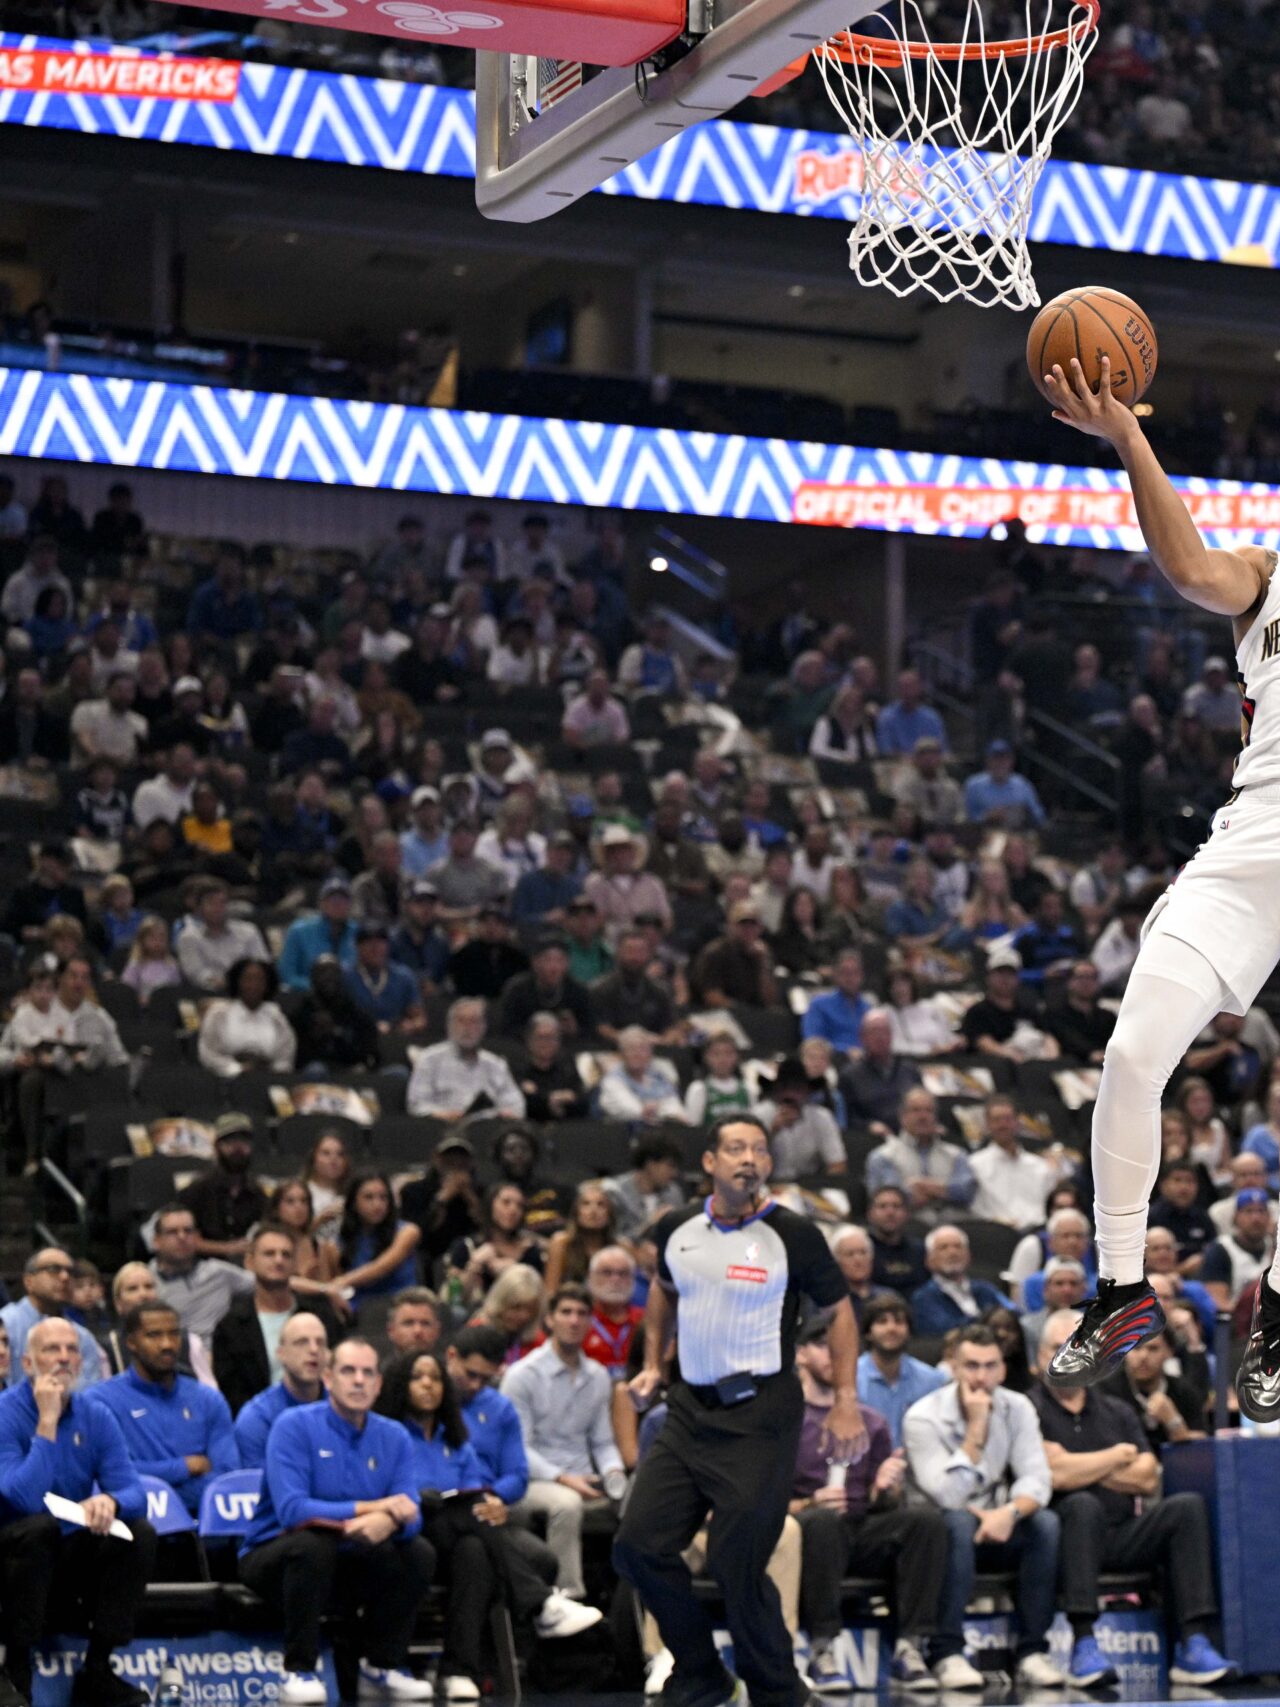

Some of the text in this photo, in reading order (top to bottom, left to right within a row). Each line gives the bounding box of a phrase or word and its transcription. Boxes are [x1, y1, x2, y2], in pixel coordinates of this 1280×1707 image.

[44, 56, 235, 97] MAVERICKS
[795, 489, 935, 521] OFFICIAL
[940, 492, 1014, 522] CHIP
[1018, 494, 1061, 523] OF
[1068, 496, 1122, 524] THE
[214, 1492, 261, 1521] UT
